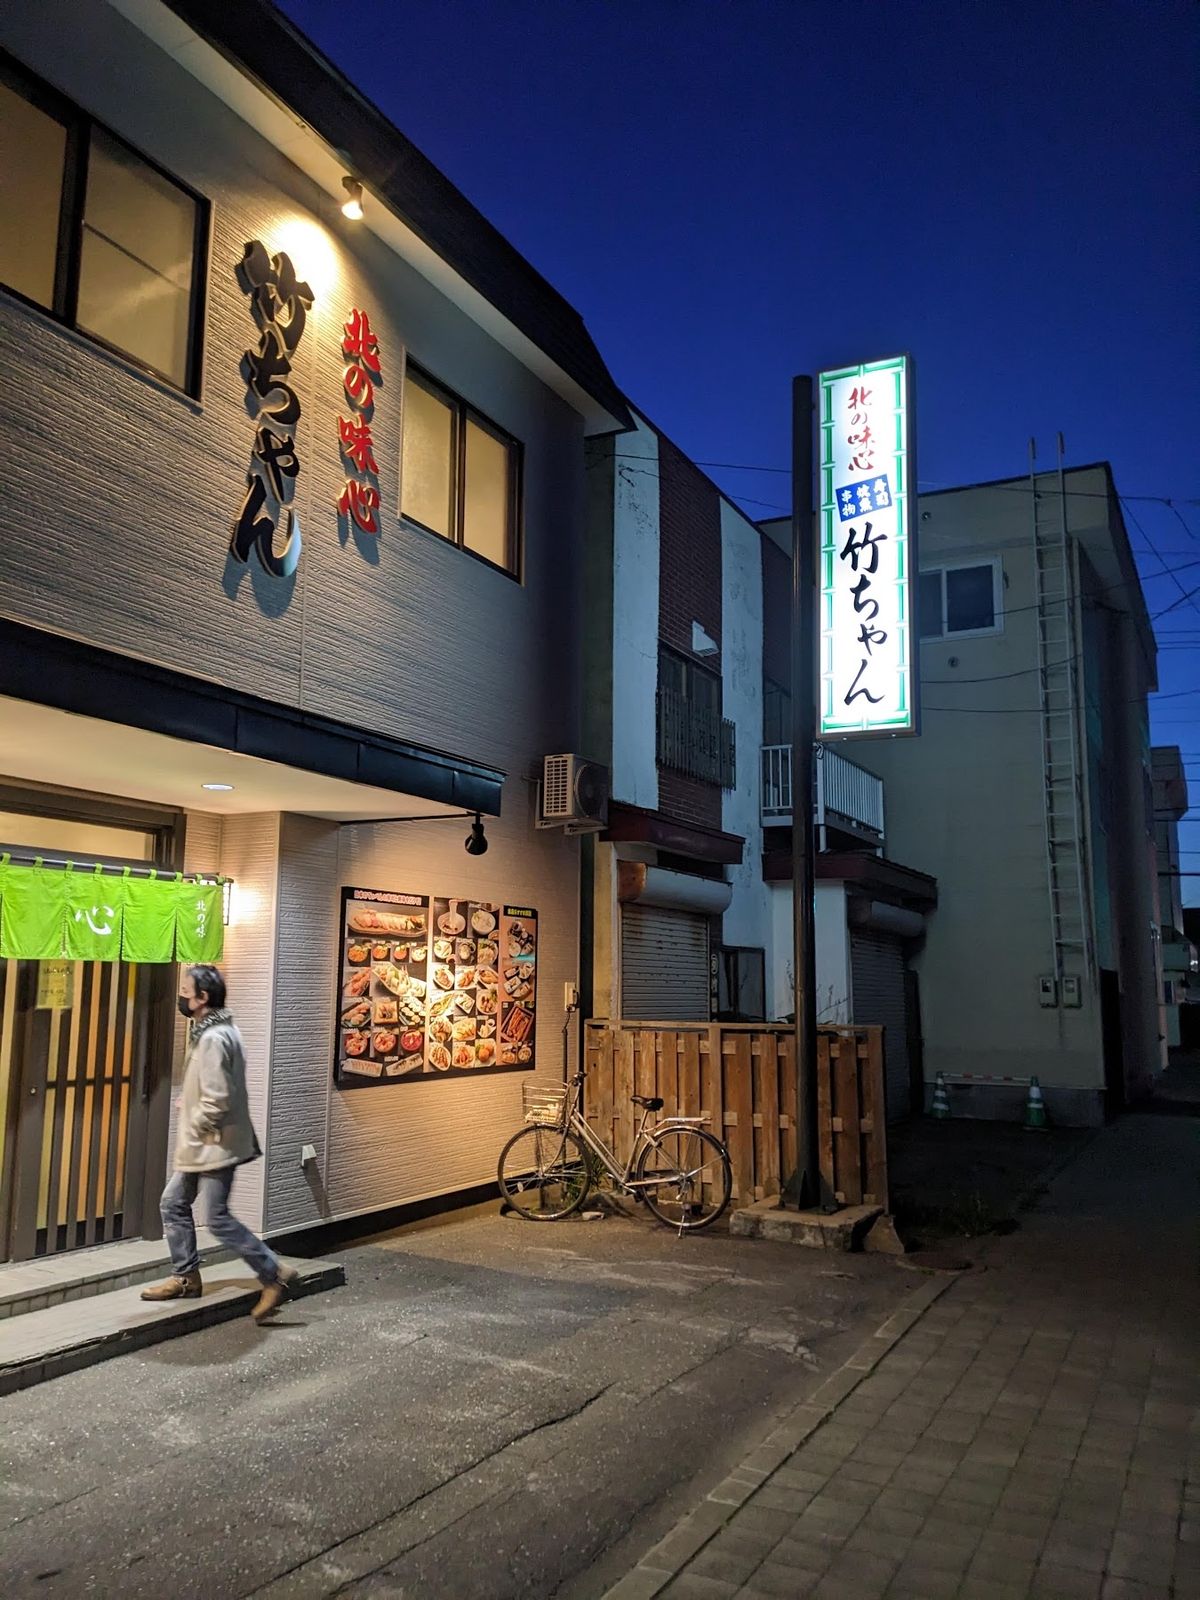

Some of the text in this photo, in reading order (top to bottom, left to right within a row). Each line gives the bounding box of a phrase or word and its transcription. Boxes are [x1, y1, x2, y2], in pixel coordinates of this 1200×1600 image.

[231, 240, 315, 578] 竹ちゃん
[338, 308, 381, 533] 北の味心
[847, 386, 875, 471] 北の味心
[841, 489, 856, 517] 串物
[840, 522, 888, 706] 竹ちゃん
[75, 905, 115, 935] 心
